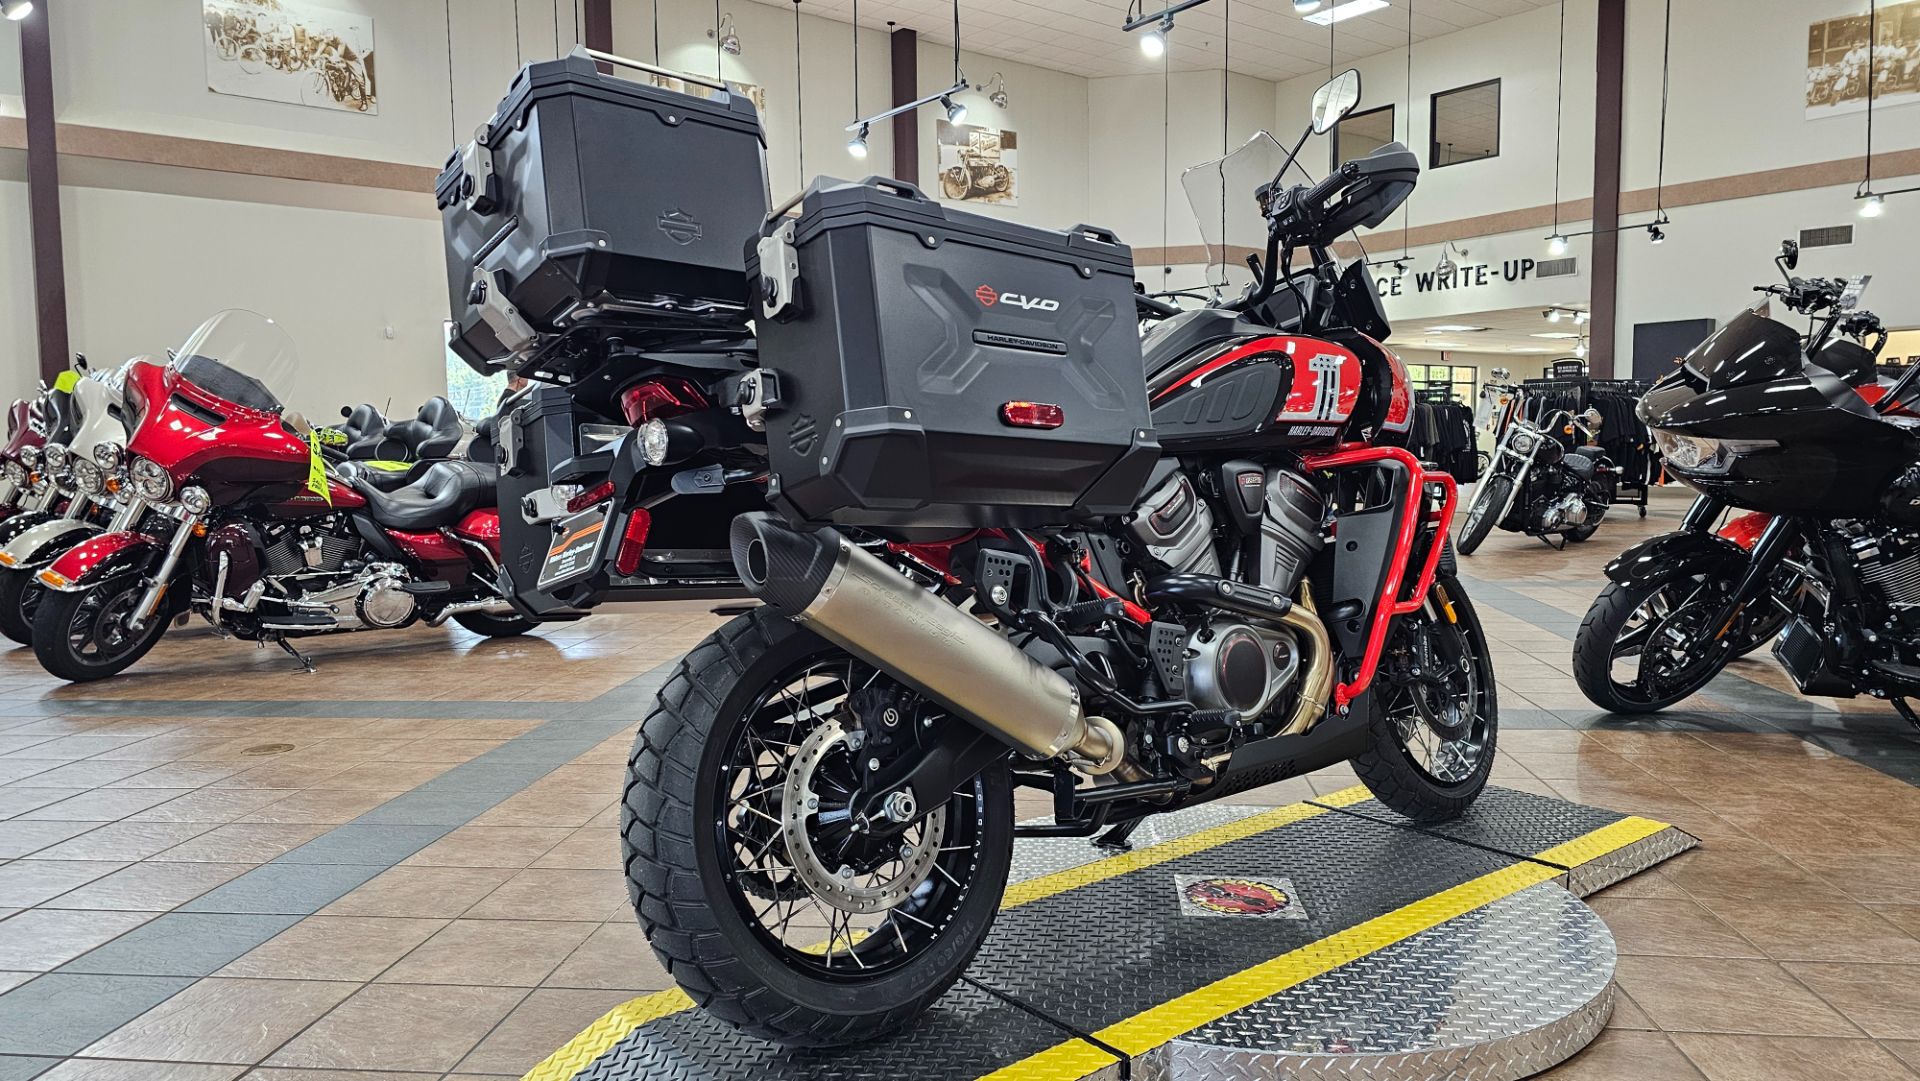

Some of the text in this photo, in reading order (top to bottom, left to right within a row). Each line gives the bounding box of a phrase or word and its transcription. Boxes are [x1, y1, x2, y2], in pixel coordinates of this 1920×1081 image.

[1415, 258, 1535, 294] WRITE-UP
[1000, 292, 1060, 311] CVO
[987, 335, 1058, 349] HARLEY-DAVIDSON
[1287, 425, 1339, 437] HARLEY-DAVIDSON
[930, 780, 983, 941] HARLEY-DAVIDSON
